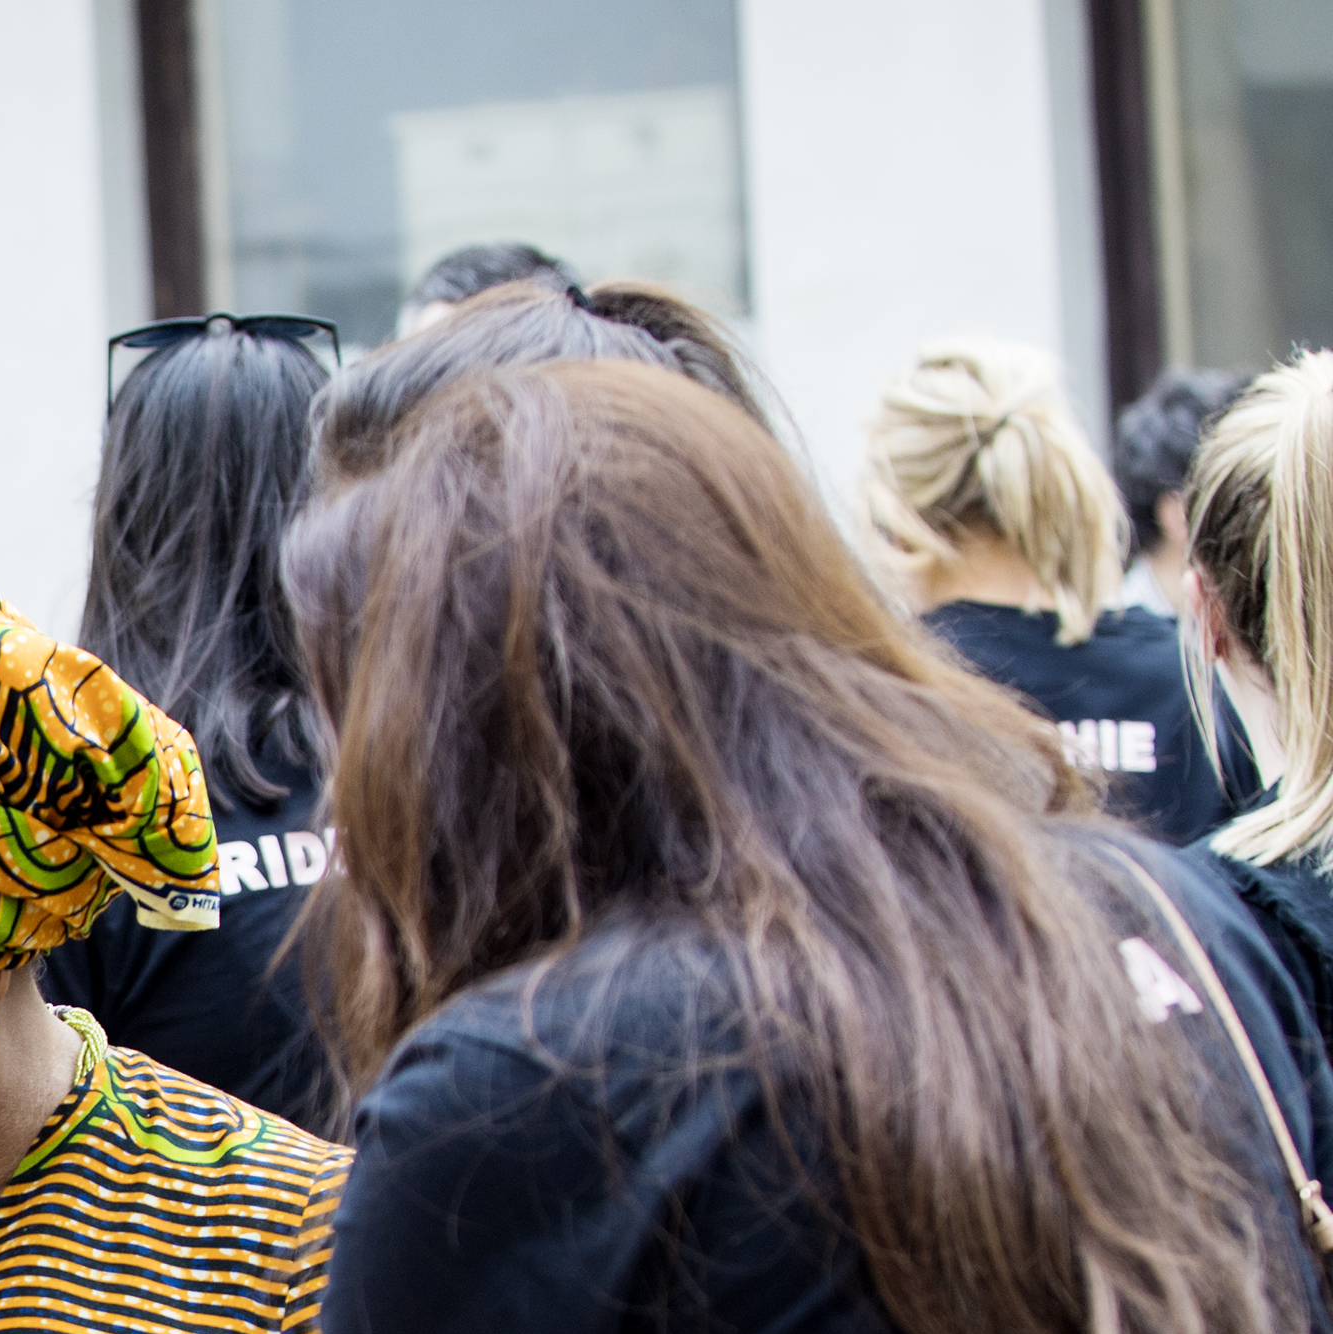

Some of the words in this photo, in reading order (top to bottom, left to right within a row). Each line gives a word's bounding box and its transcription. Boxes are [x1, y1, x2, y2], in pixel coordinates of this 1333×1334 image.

[216, 826, 350, 896] RID
[192, 897, 221, 912] HITA
[1117, 936, 1205, 1025] A
